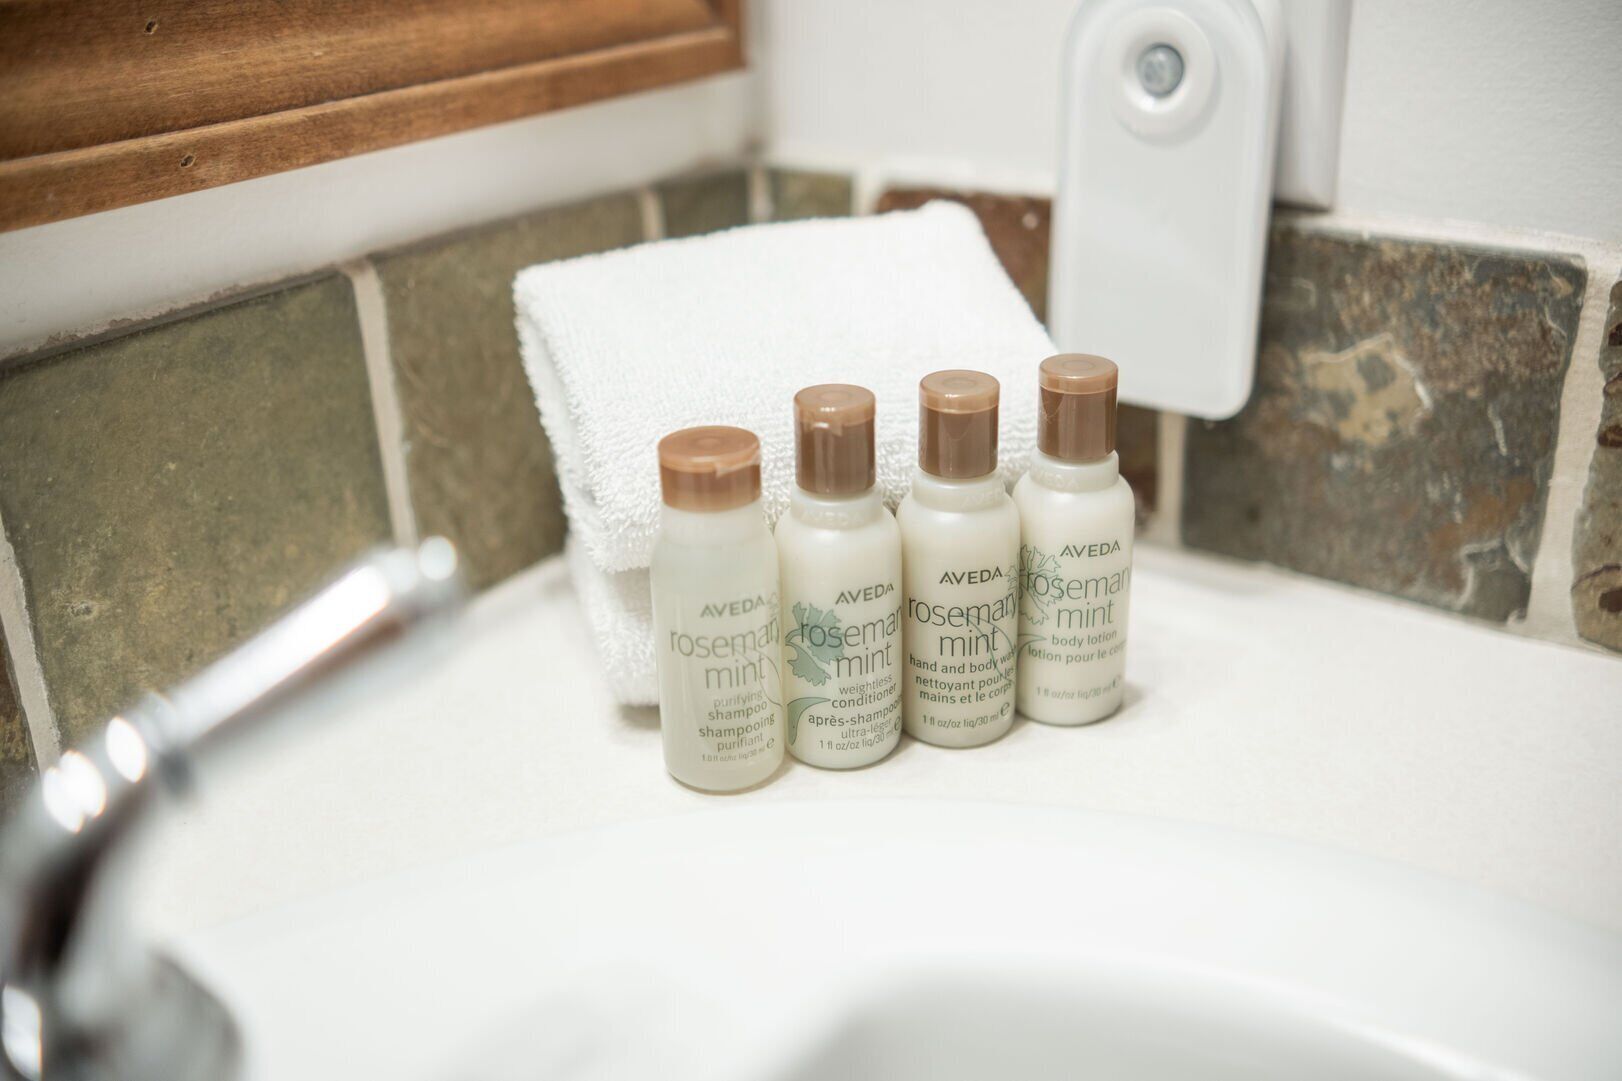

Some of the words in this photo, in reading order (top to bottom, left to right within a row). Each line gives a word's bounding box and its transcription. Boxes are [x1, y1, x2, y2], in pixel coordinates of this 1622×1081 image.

[1060, 539, 1121, 559] AVEDA
[939, 566, 1003, 585] AVEDA
[835, 583, 895, 605] AVEDA
[699, 595, 765, 618] AVEDA
[1057, 599, 1115, 629] mint
[800, 605, 902, 649] rosemar
[939, 626, 999, 657] mint
[1052, 634, 1084, 648] body
[1087, 630, 1118, 646] lotion
[836, 641, 893, 678] mint
[909, 653, 937, 672] hand
[941, 662, 966, 675] and
[969, 659, 999, 673] body
[1028, 644, 1062, 662] lotion
[1066, 652, 1095, 665] pour
[1097, 648, 1108, 660] le
[705, 654, 766, 689] mint
[839, 674, 893, 695] weightless
[915, 675, 975, 693] nettoyant
[713, 690, 763, 710] purifying
[831, 683, 897, 709] conditioner
[919, 690, 957, 705] mains
[960, 694, 972, 704] et
[975, 691, 986, 702] le
[708, 700, 768, 721] shampoo
[698, 713, 775, 739] shampooing
[922, 714, 927, 724] 1
[937, 719, 961, 729] oz/oz
[963, 715, 989, 729] liq/30
[717, 732, 763, 753] purifiant
